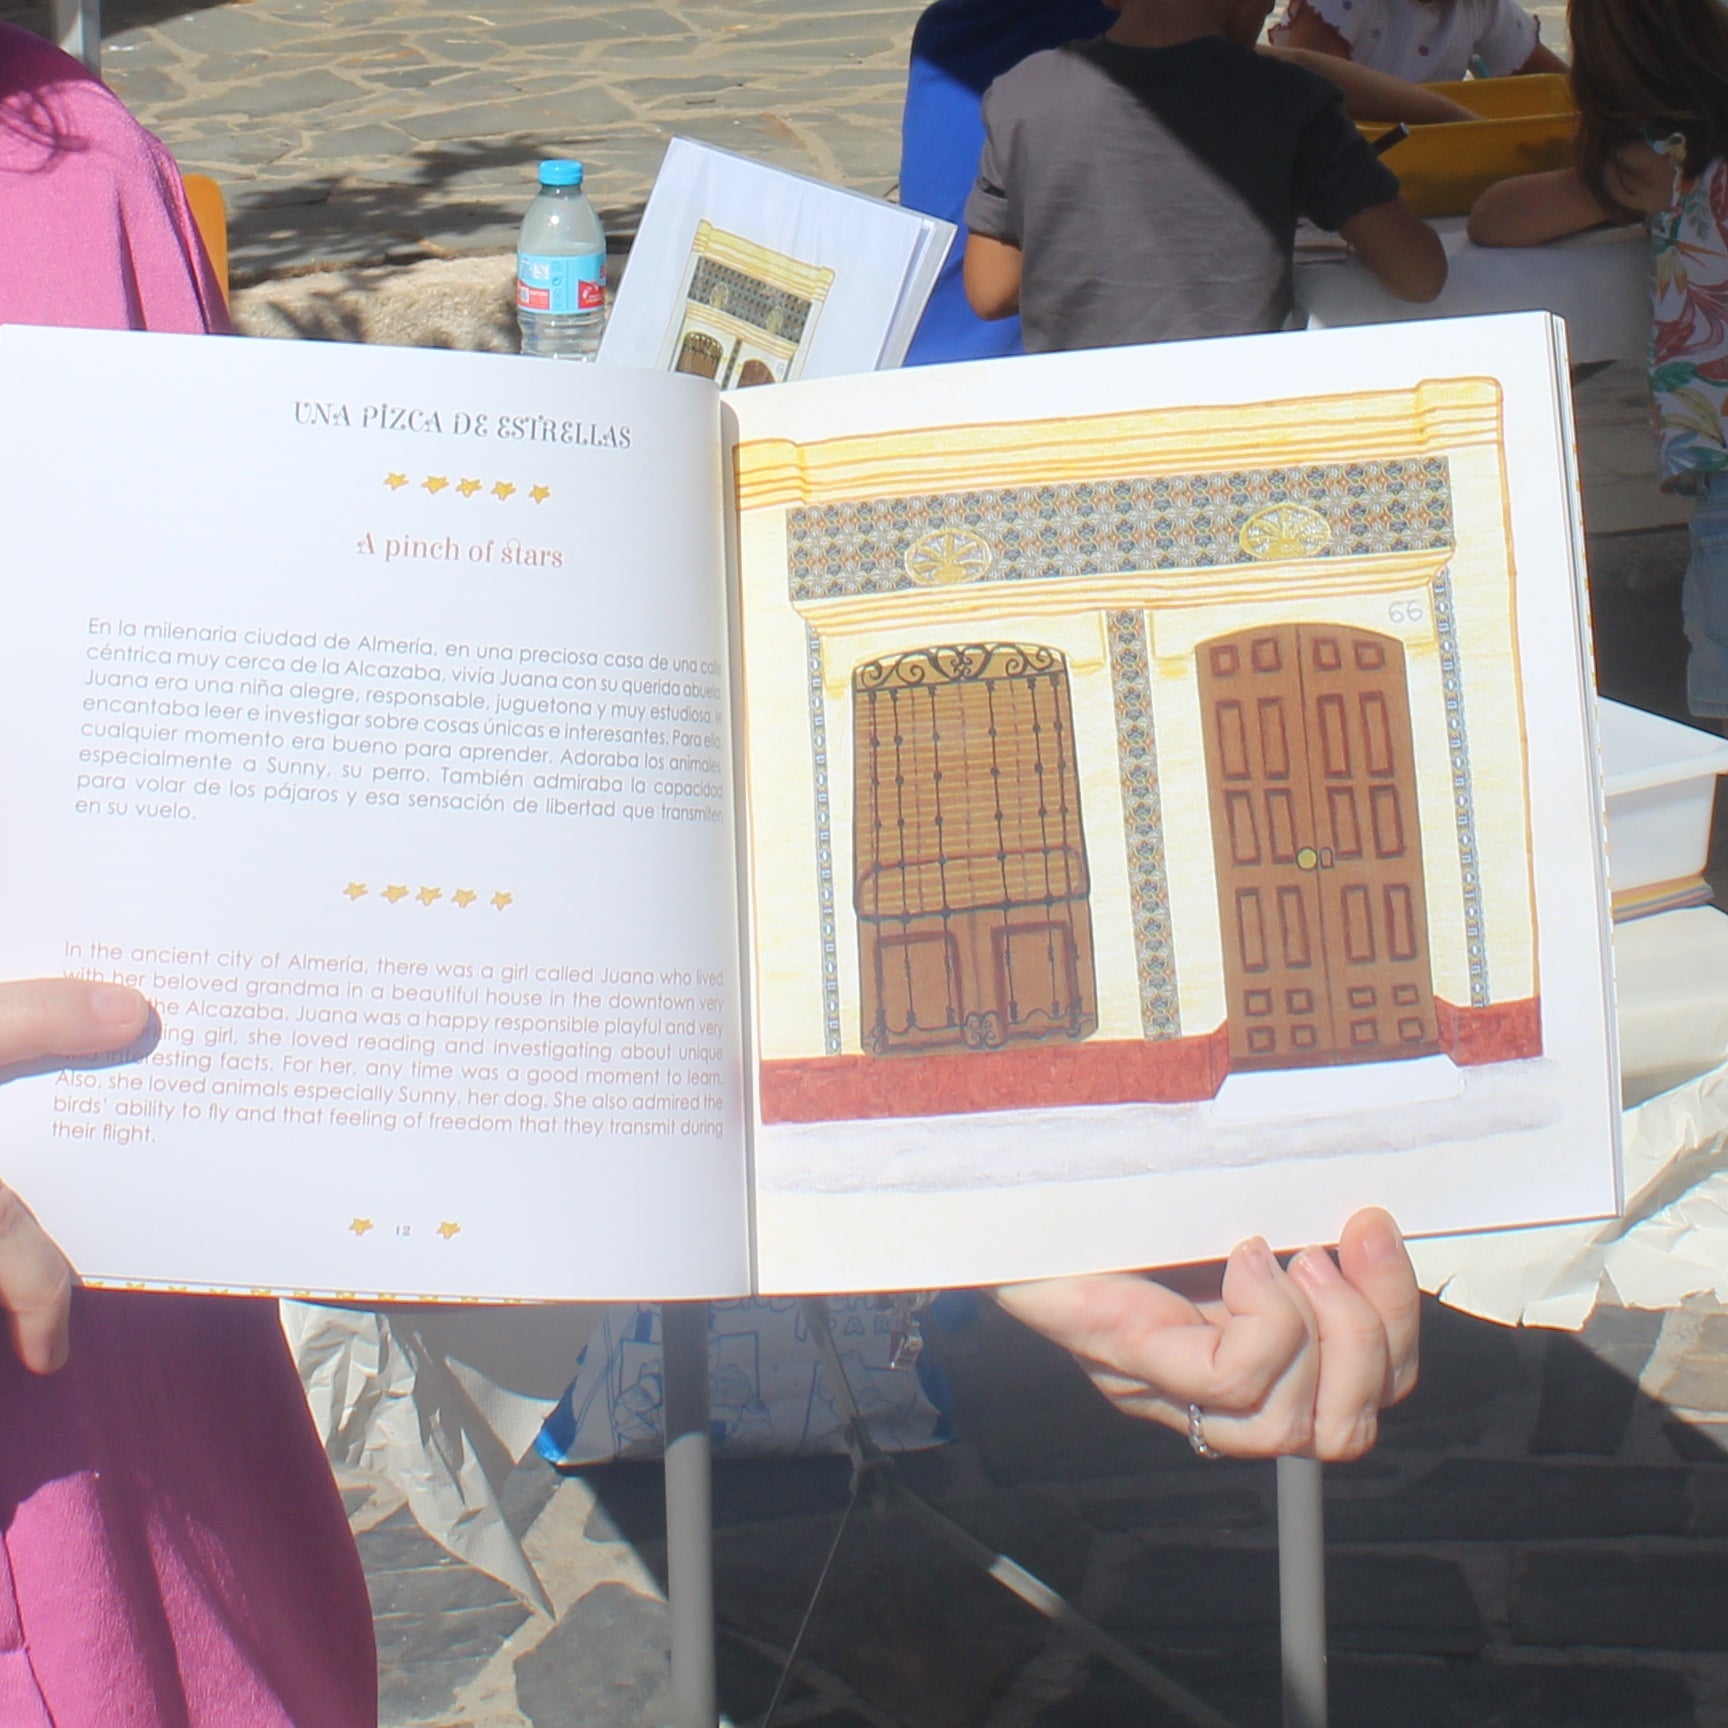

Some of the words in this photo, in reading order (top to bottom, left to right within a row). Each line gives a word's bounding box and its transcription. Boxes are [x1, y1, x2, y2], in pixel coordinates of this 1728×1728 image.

[294, 401, 351, 427] UNA
[453, 412, 488, 437] DE
[497, 414, 632, 450] ESTRELLAS
[356, 532, 375, 555] A
[384, 534, 460, 563] pinch
[468, 539, 495, 563] of
[500, 537, 564, 568] stars
[1388, 599, 1424, 623] 66
[88, 617, 112, 636] En
[117, 619, 137, 638] la
[143, 622, 238, 644] milenaria
[243, 627, 318, 649] ciudad
[323, 632, 351, 650] de
[356, 635, 438, 658] Almería,
[444, 643, 470, 658] en
[476, 646, 514, 661] una
[519, 646, 599, 667] preciosa
[603, 653, 644, 670] casa
[648, 653, 670, 672] de
[672, 659, 698, 674] una
[86, 642, 172, 665] céntrica
[176, 652, 221, 671] muy
[224, 654, 286, 672] cerca
[289, 655, 318, 674] de
[321, 657, 340, 676] la
[344, 659, 446, 684] Alcazaba,
[451, 665, 496, 685] vivía
[499, 669, 558, 689] Juana
[561, 676, 598, 692] con
[600, 678, 618, 693] su
[621, 678, 681, 697] querida
[84, 668, 149, 689] Juana
[154, 676, 189, 692] era
[194, 679, 234, 694] una
[239, 678, 284, 698] niña
[289, 681, 360, 705] alegre,
[365, 689, 490, 712] responsable,
[495, 693, 592, 716] juguetona
[596, 703, 608, 721] y
[610, 703, 647, 723] muy
[82, 697, 200, 718] encantaba
[204, 701, 244, 720] leer
[246, 707, 261, 722] e
[264, 704, 362, 731] investigar
[364, 711, 420, 732] sobre
[423, 718, 480, 735] cosas
[483, 717, 545, 739] únicas
[548, 725, 562, 740] e
[564, 722, 670, 746] interesantes.
[80, 721, 178, 744] cualquier
[184, 729, 285, 749] momento
[291, 735, 326, 752] era
[332, 734, 398, 756] bueno
[404, 742, 452, 760] para
[458, 745, 553, 764] aprender.
[559, 748, 640, 769] Adoraba
[644, 751, 665, 771] los
[78, 747, 233, 772] especialmente
[242, 758, 257, 773] a
[266, 755, 332, 781] Sunny,
[341, 764, 363, 779] su
[372, 766, 430, 784] perro.
[441, 766, 524, 788] También
[532, 772, 624, 793] admiraba
[630, 776, 646, 794] la
[74, 799, 102, 814] en
[107, 801, 129, 817] su
[134, 801, 196, 821] vuelo.
[76, 774, 126, 791] para
[135, 775, 187, 794] volar
[193, 778, 222, 796] de
[229, 779, 256, 799] los
[263, 781, 339, 805] pájaros
[346, 790, 358, 808] y
[365, 791, 400, 807] esa
[407, 793, 505, 812] sensación
[512, 796, 539, 814] de
[545, 797, 616, 818] libertad
[622, 804, 656, 822] que
[55, 1073, 102, 1090] Also,
[107, 1072, 144, 1092] she
[148, 1074, 207, 1094] loved
[211, 1078, 289, 1098] animals
[293, 1083, 394, 1106] especially
[398, 1085, 462, 1109] Sunny,
[467, 1087, 500, 1106] her
[503, 1089, 548, 1112] dog.
[552, 1090, 588, 1110] She
[591, 1092, 628, 1110] also
[631, 1092, 700, 1112] admired
[703, 1093, 724, 1112] the
[52, 1120, 97, 1140] their
[102, 1122, 156, 1146] flight.
[53, 1095, 108, 1115] birds'
[114, 1098, 176, 1122] ability
[182, 1101, 202, 1120] to
[208, 1102, 230, 1124] fly
[235, 1105, 276, 1123] and
[283, 1106, 324, 1125] that
[329, 1107, 398, 1132] feeling
[402, 1111, 424, 1129] of
[429, 1111, 513, 1132] freedom
[519, 1114, 558, 1134] that
[563, 1116, 604, 1138] they
[609, 1117, 676, 1136] transmit
[680, 1117, 724, 1140] during
